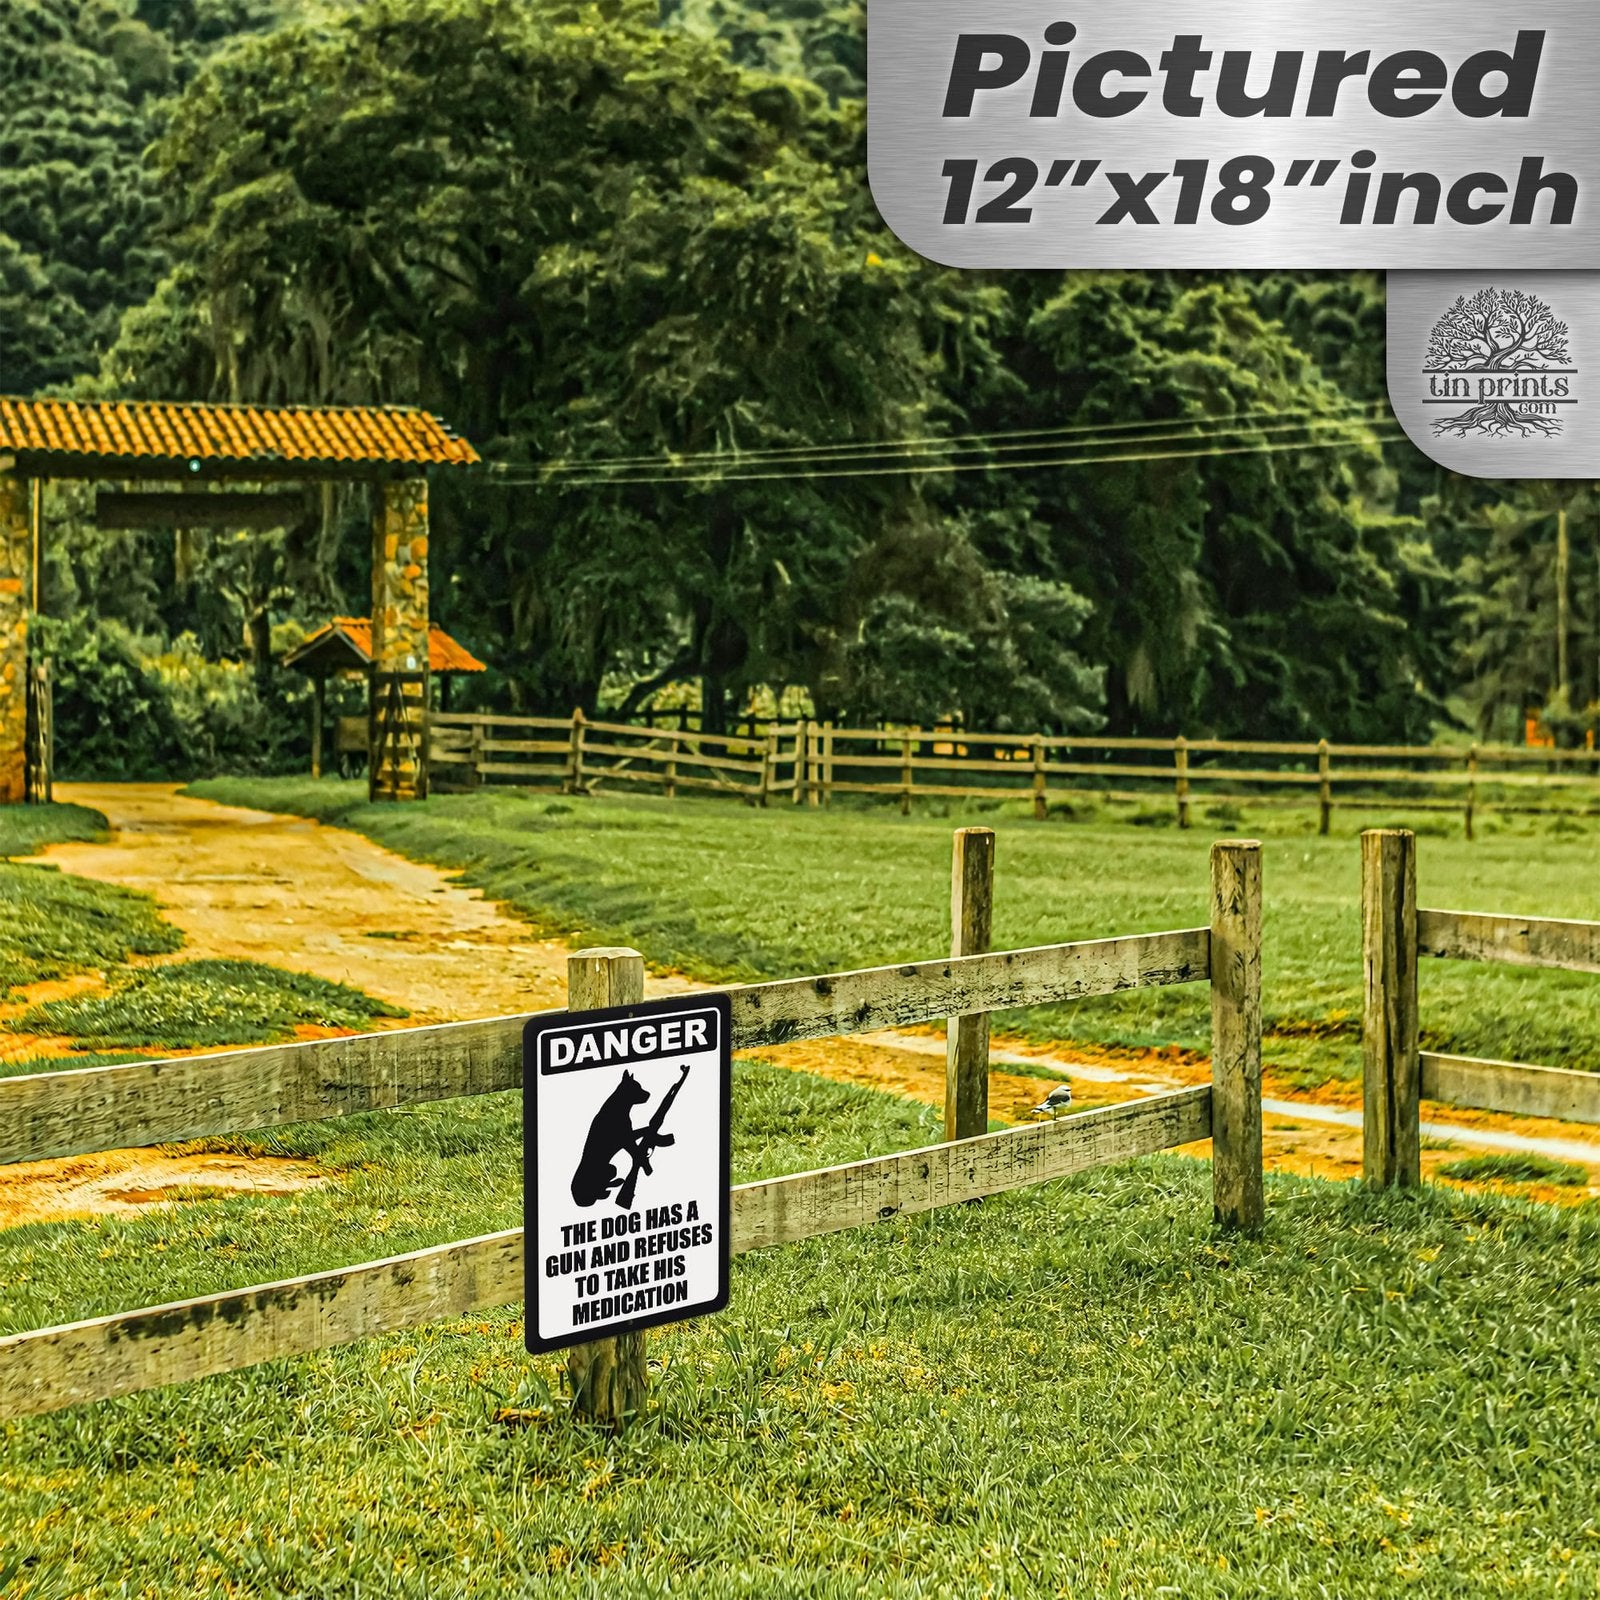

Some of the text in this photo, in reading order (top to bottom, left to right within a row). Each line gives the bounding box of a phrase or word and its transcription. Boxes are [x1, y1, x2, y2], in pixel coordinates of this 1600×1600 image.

[549, 1018, 709, 1068] DANGER
[561, 1200, 699, 1247] THE DOG HAS A
[545, 1223, 713, 1278] GUN AND REFUSES
[575, 1255, 686, 1298] TO TAKE HIS
[572, 1280, 689, 1327] MEDICATION
